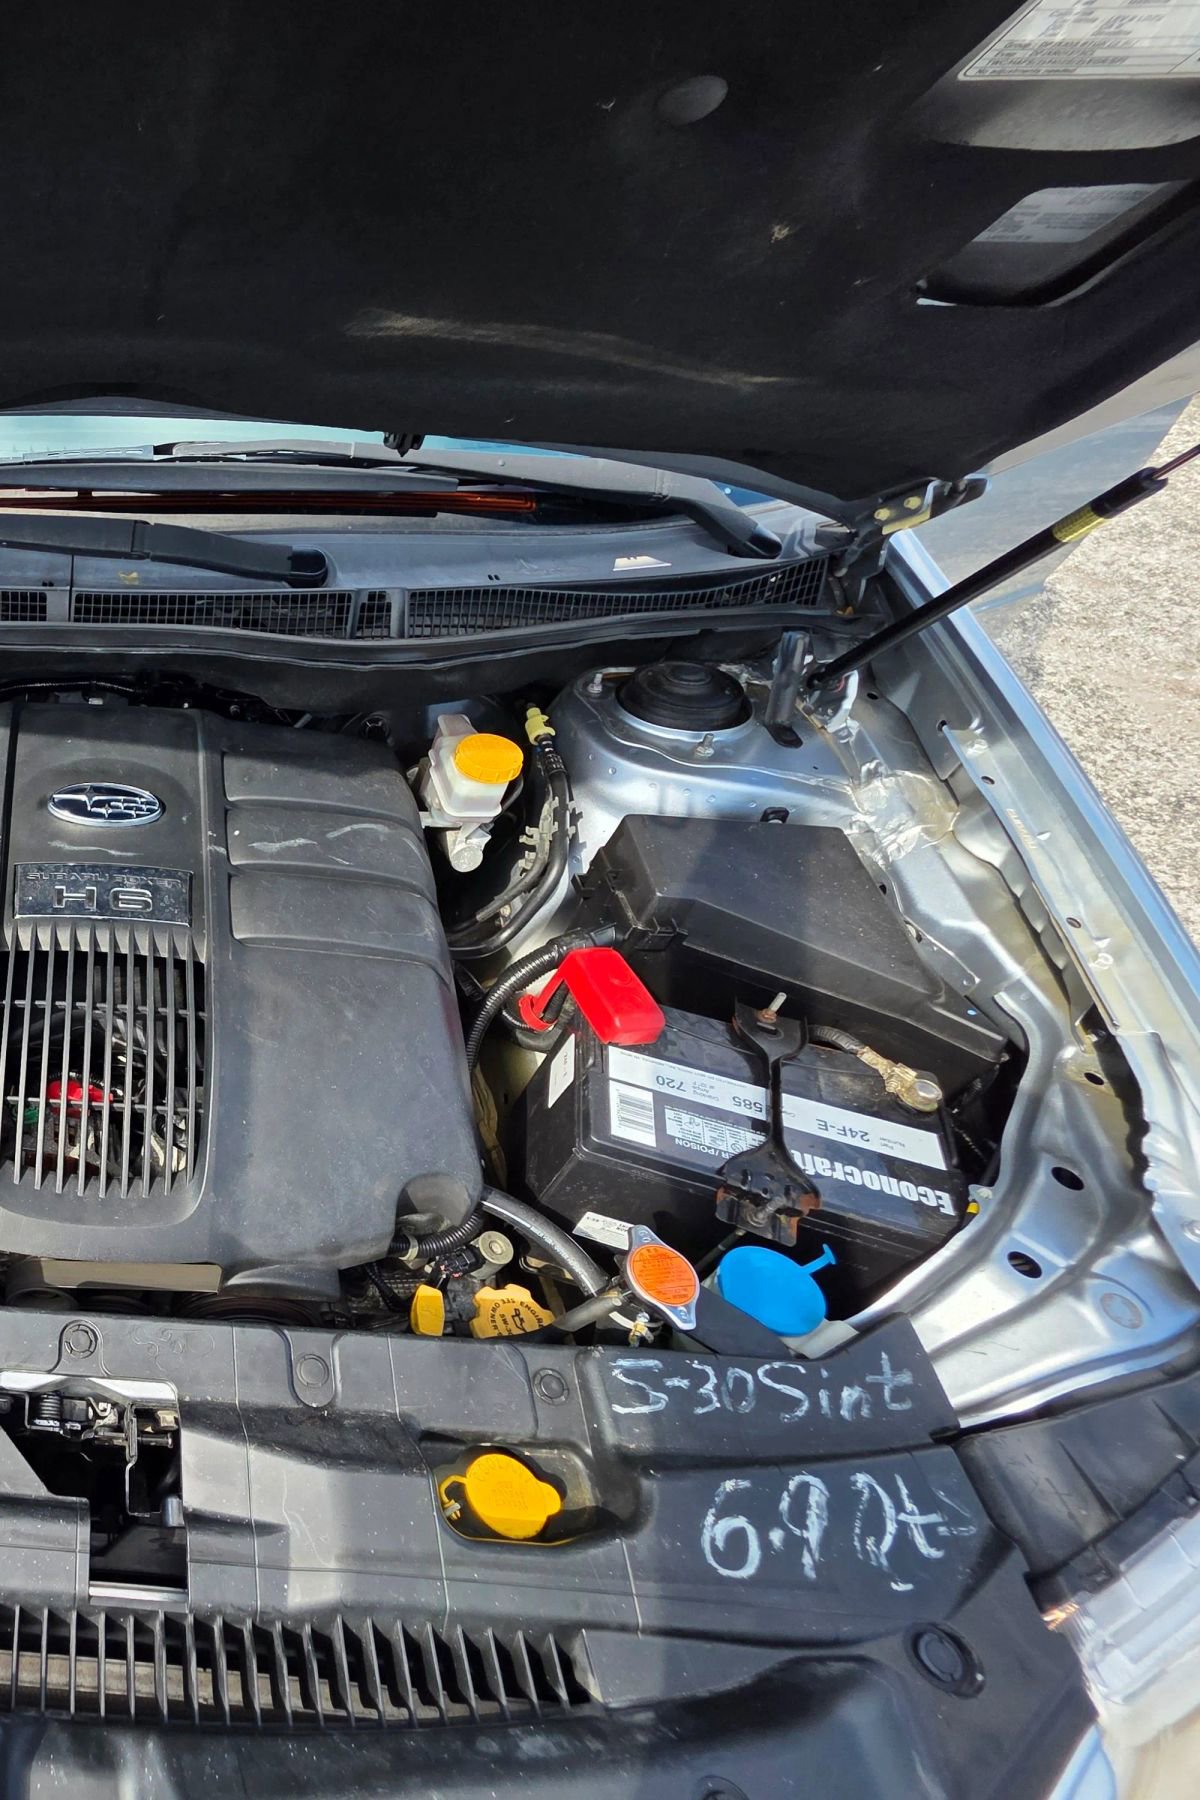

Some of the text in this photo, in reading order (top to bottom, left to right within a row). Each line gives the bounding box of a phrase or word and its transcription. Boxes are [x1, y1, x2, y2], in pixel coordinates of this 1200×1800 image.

[26, 871, 109, 882] SUBARU
[52, 885, 153, 912] H6
[655, 1075, 687, 1092] 720
[731, 1095, 763, 1113] 585
[814, 1118, 871, 1143] 24F-E
[790, 1150, 956, 1216] Econocraft
